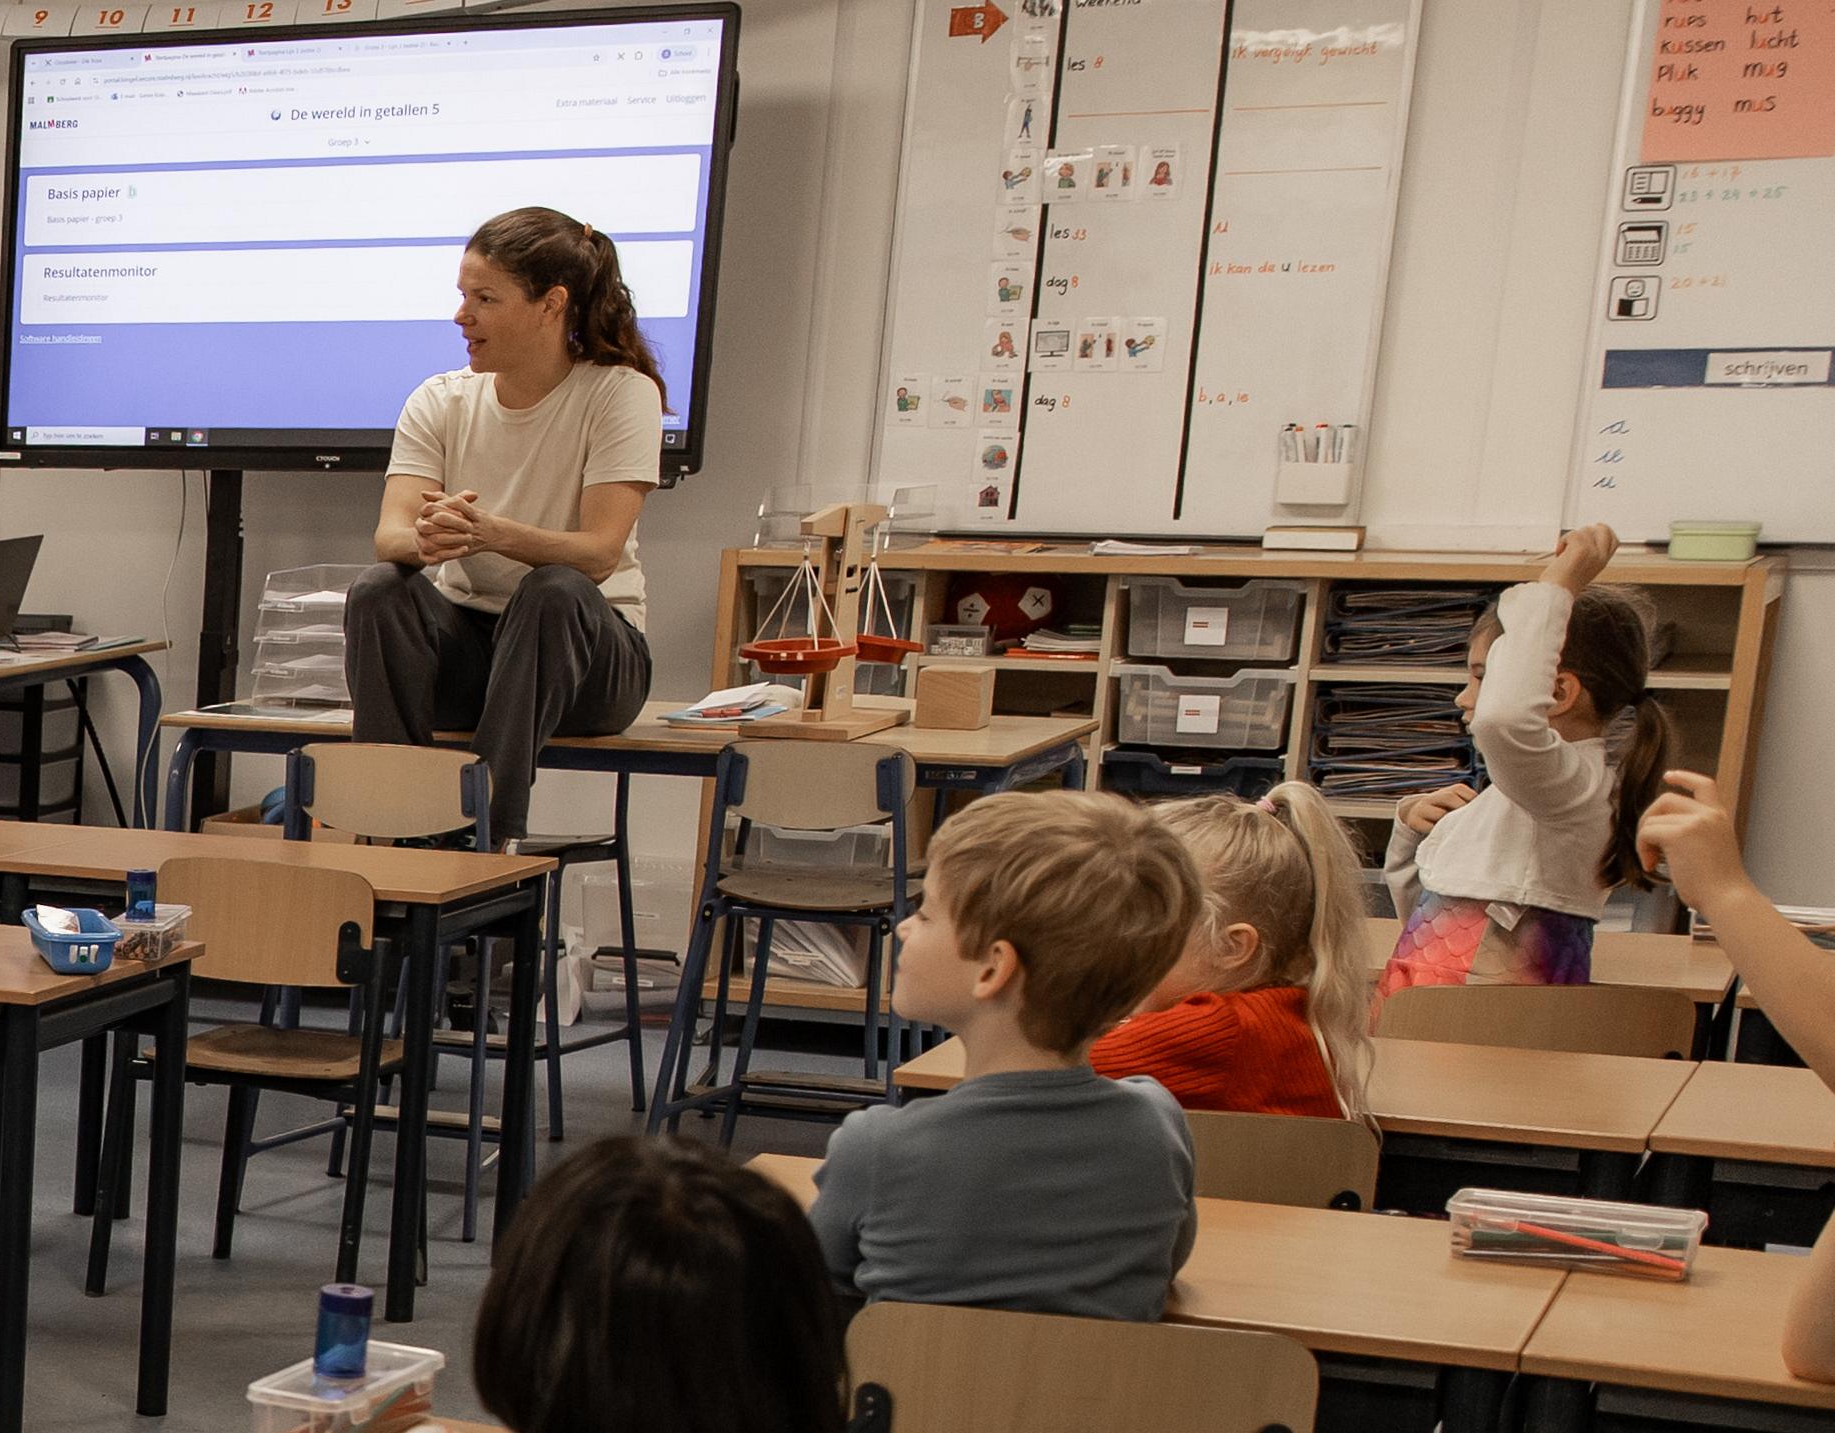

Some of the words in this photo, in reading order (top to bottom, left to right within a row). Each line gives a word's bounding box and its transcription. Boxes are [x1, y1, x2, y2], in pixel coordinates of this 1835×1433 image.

[35, 10, 49, 25] 9
[99, 10, 125, 25] 10
[171, 8, 196, 23] 11
[246, 3, 273, 19] 12
[1665, 14, 1707, 28] rups
[1745, 5, 1784, 25] hut
[1750, 28, 1800, 50] lucht
[1067, 56, 1085, 71] les
[1742, 61, 1789, 79] mug
[627, 96, 656, 105] Service
[1733, 95, 1777, 113] mus
[291, 109, 308, 121] De
[312, 106, 355, 120] wereld
[360, 105, 371, 118] in
[375, 103, 428, 121] getallen
[432, 104, 440, 116] 5
[1652, 97, 1706, 125] buggy
[30, 119, 79, 130] MALMBERG
[48, 187, 79, 200] Basis
[81, 186, 121, 202] papier
[1050, 223, 1070, 239] les
[43, 266, 158, 280] Resultatenmonitor
[1226, 263, 1252, 274] kan
[1281, 262, 1291, 272] u
[1297, 260, 1336, 273] lezen
[1046, 276, 1068, 295] dag
[1725, 360, 1808, 379] schrijven
[1034, 396, 1056, 411] dag
